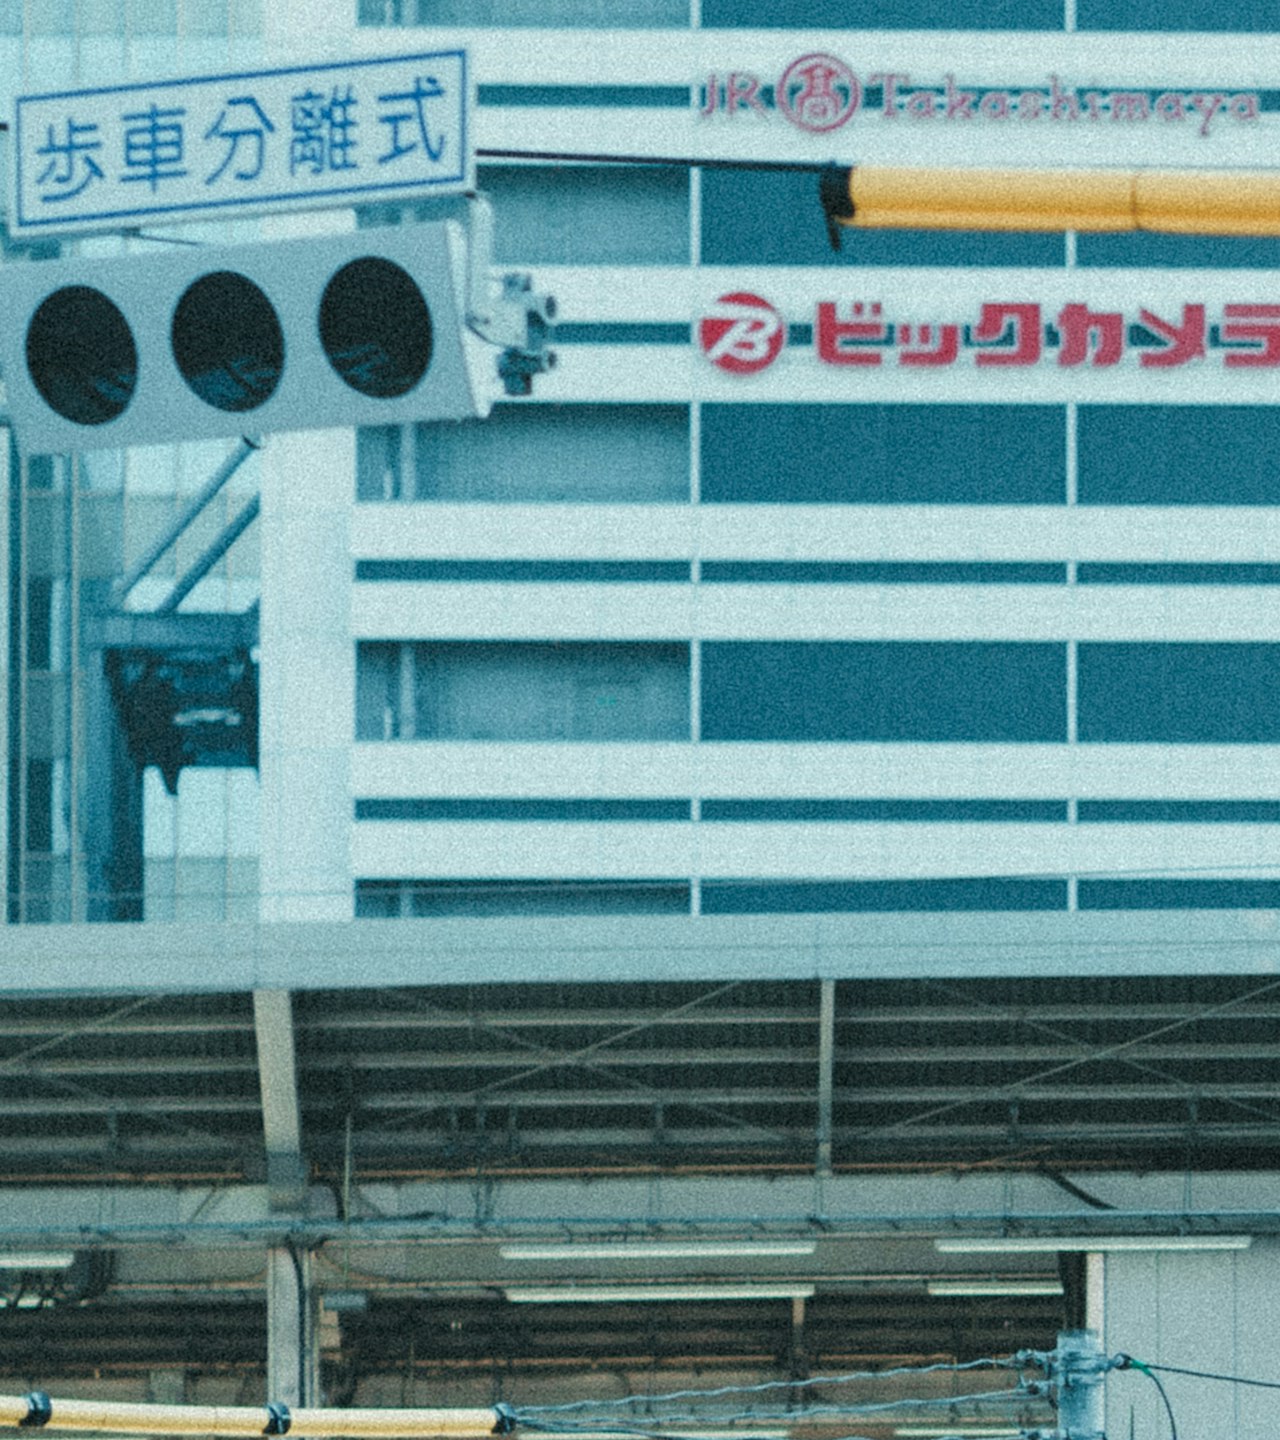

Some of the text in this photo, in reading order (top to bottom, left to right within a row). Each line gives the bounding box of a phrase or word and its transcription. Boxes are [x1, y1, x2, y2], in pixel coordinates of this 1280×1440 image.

[35, 76, 449, 205] 歩車分離式
[704, 72, 767, 117] JR
[868, 73, 1260, 137] Takashimaya
